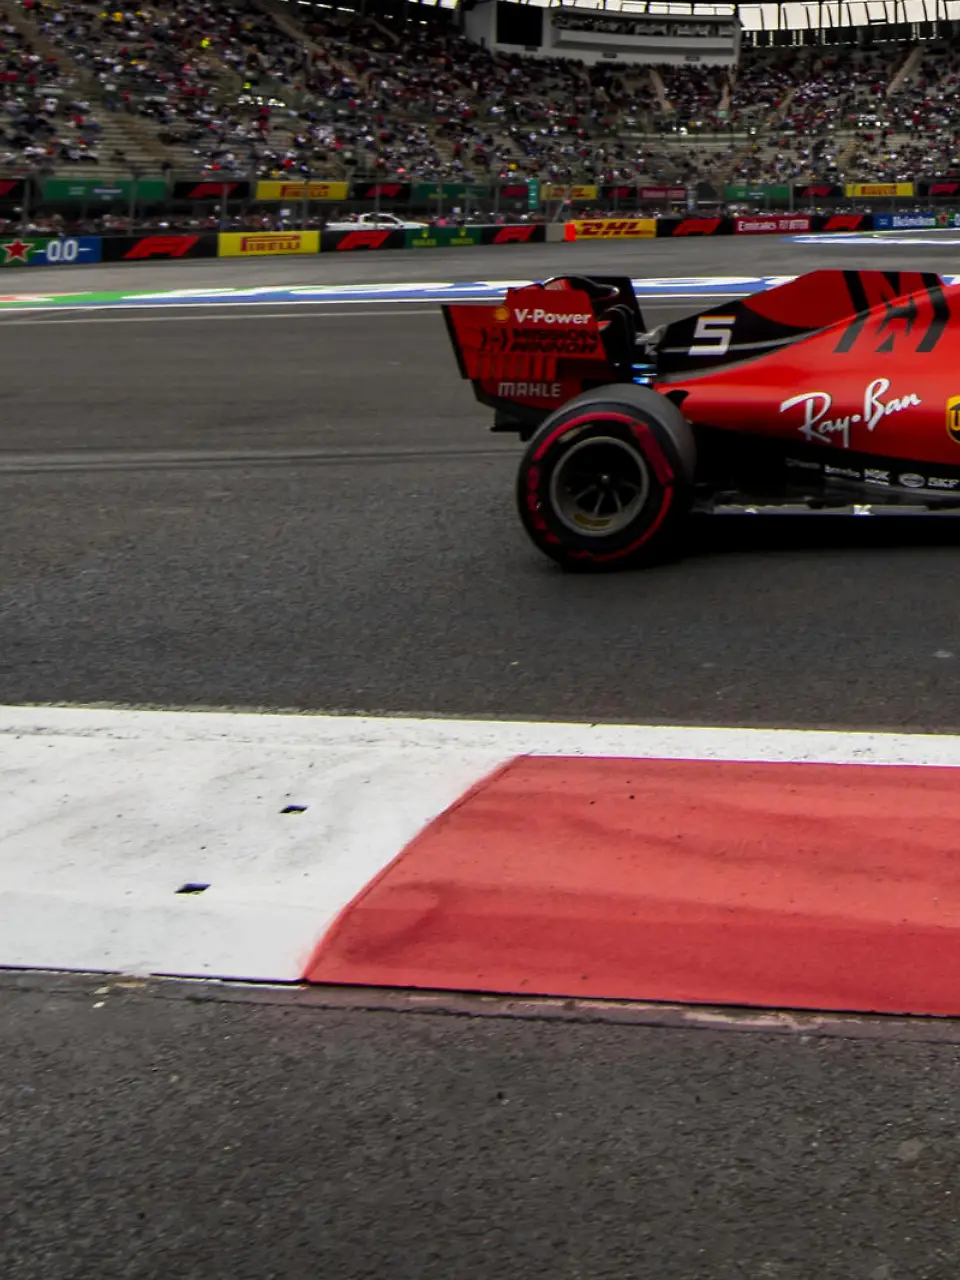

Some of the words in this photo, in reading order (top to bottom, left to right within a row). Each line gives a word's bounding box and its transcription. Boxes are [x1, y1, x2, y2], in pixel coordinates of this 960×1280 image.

[581, 222, 642, 235] DHL
[240, 235, 302, 252] PIRELLI
[514, 308, 593, 325] V-Power
[688, 316, 736, 356] 5
[498, 382, 562, 398] MAHLE
